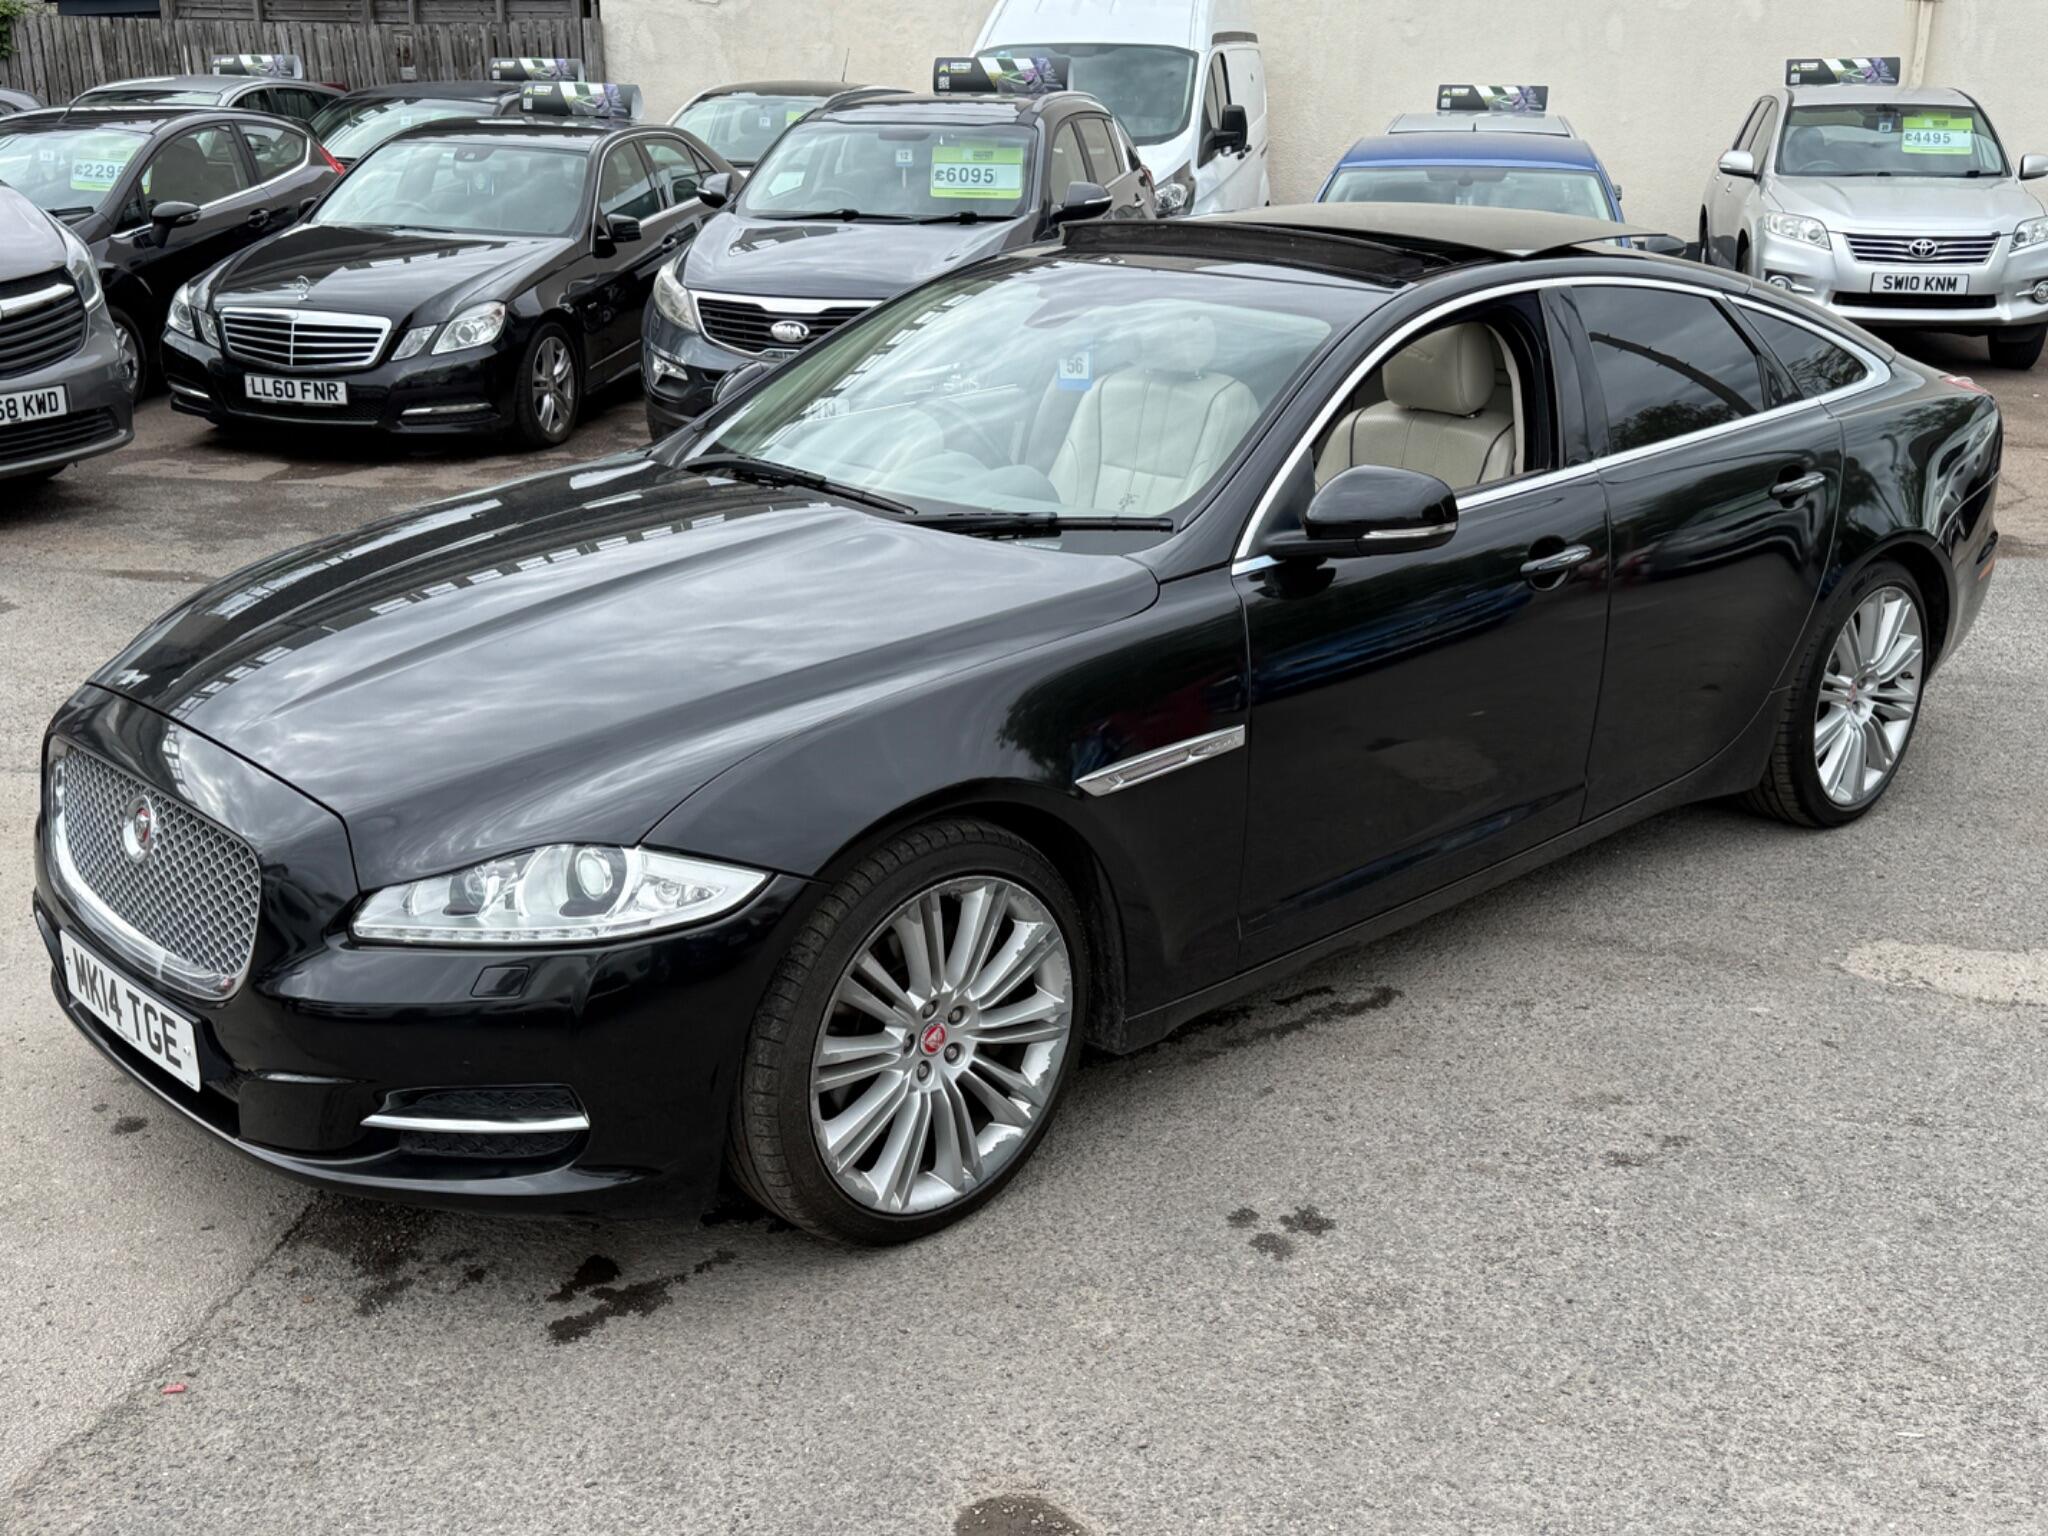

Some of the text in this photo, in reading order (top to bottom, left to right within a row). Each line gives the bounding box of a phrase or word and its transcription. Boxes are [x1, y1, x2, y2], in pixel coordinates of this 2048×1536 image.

[935, 167, 994, 183] £6095
[1882, 275, 1958, 292] SW10 KNM
[1067, 356, 1084, 375] 56
[251, 377, 339, 401] LL60 FNR
[23, 391, 59, 417] KWD
[72, 947, 183, 1070] MK14 TGE
